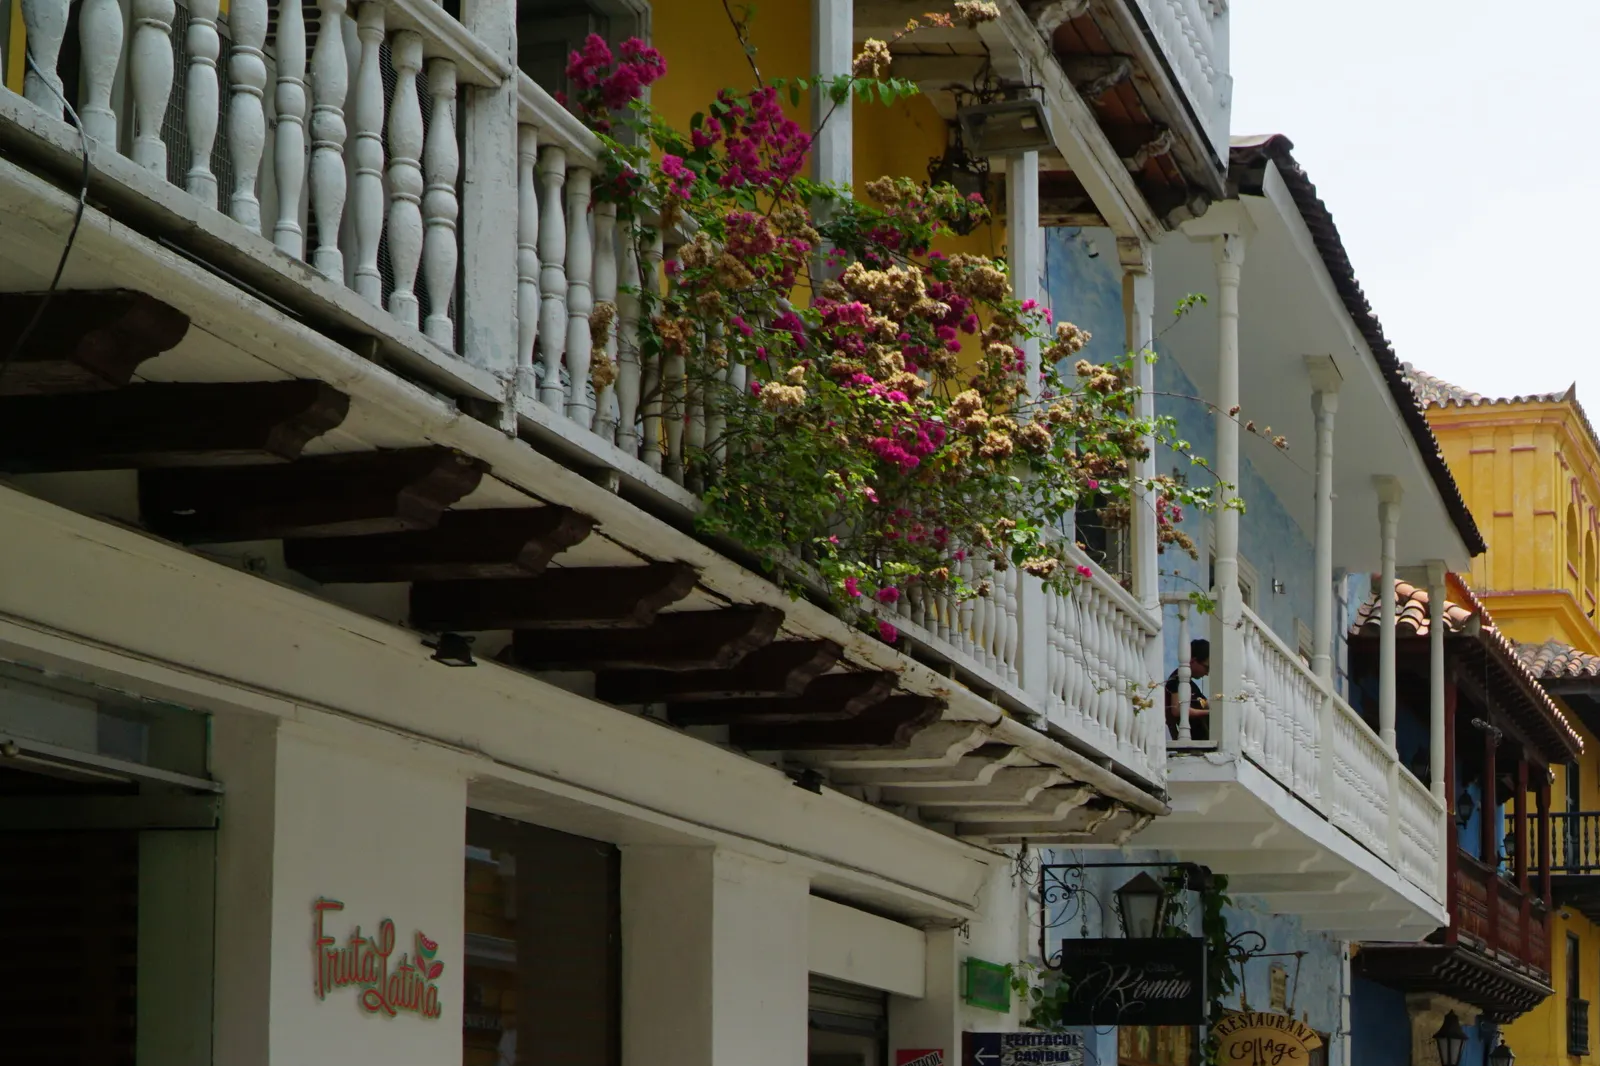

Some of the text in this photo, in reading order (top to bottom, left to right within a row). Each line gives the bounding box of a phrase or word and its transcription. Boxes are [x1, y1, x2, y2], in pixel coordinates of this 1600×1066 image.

[314, 897, 442, 1019] Fruta Latina
[1216, 1012, 1318, 1043] RESTAURANT
[1005, 1034, 1079, 1046] PERITACOL
[1014, 1051, 1070, 1062] CAMBIO
